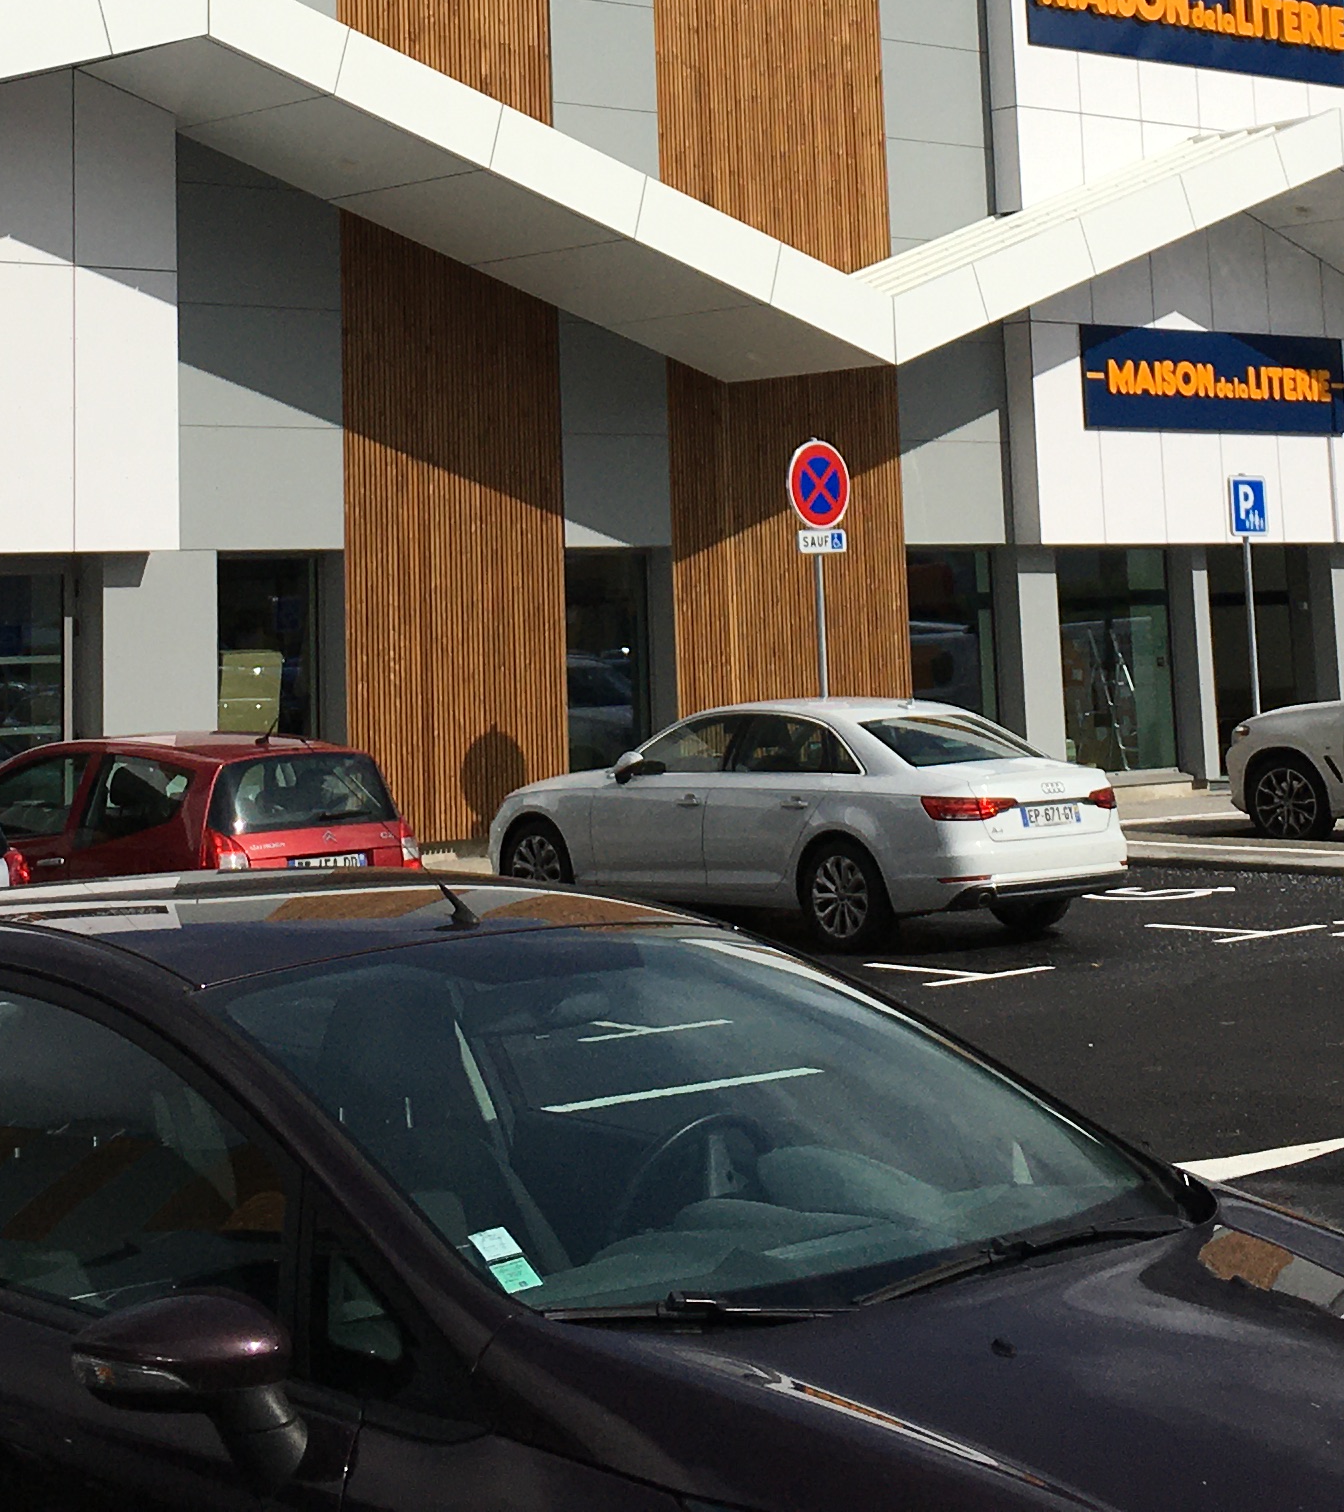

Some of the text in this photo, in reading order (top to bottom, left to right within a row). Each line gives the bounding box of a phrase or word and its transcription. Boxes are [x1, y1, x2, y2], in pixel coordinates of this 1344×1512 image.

[1107, 358, 1215, 398] MAISON
[1247, 365, 1333, 403] LITERIE
[1238, 483, 1255, 520] P
[802, 535, 830, 548] SAUF
